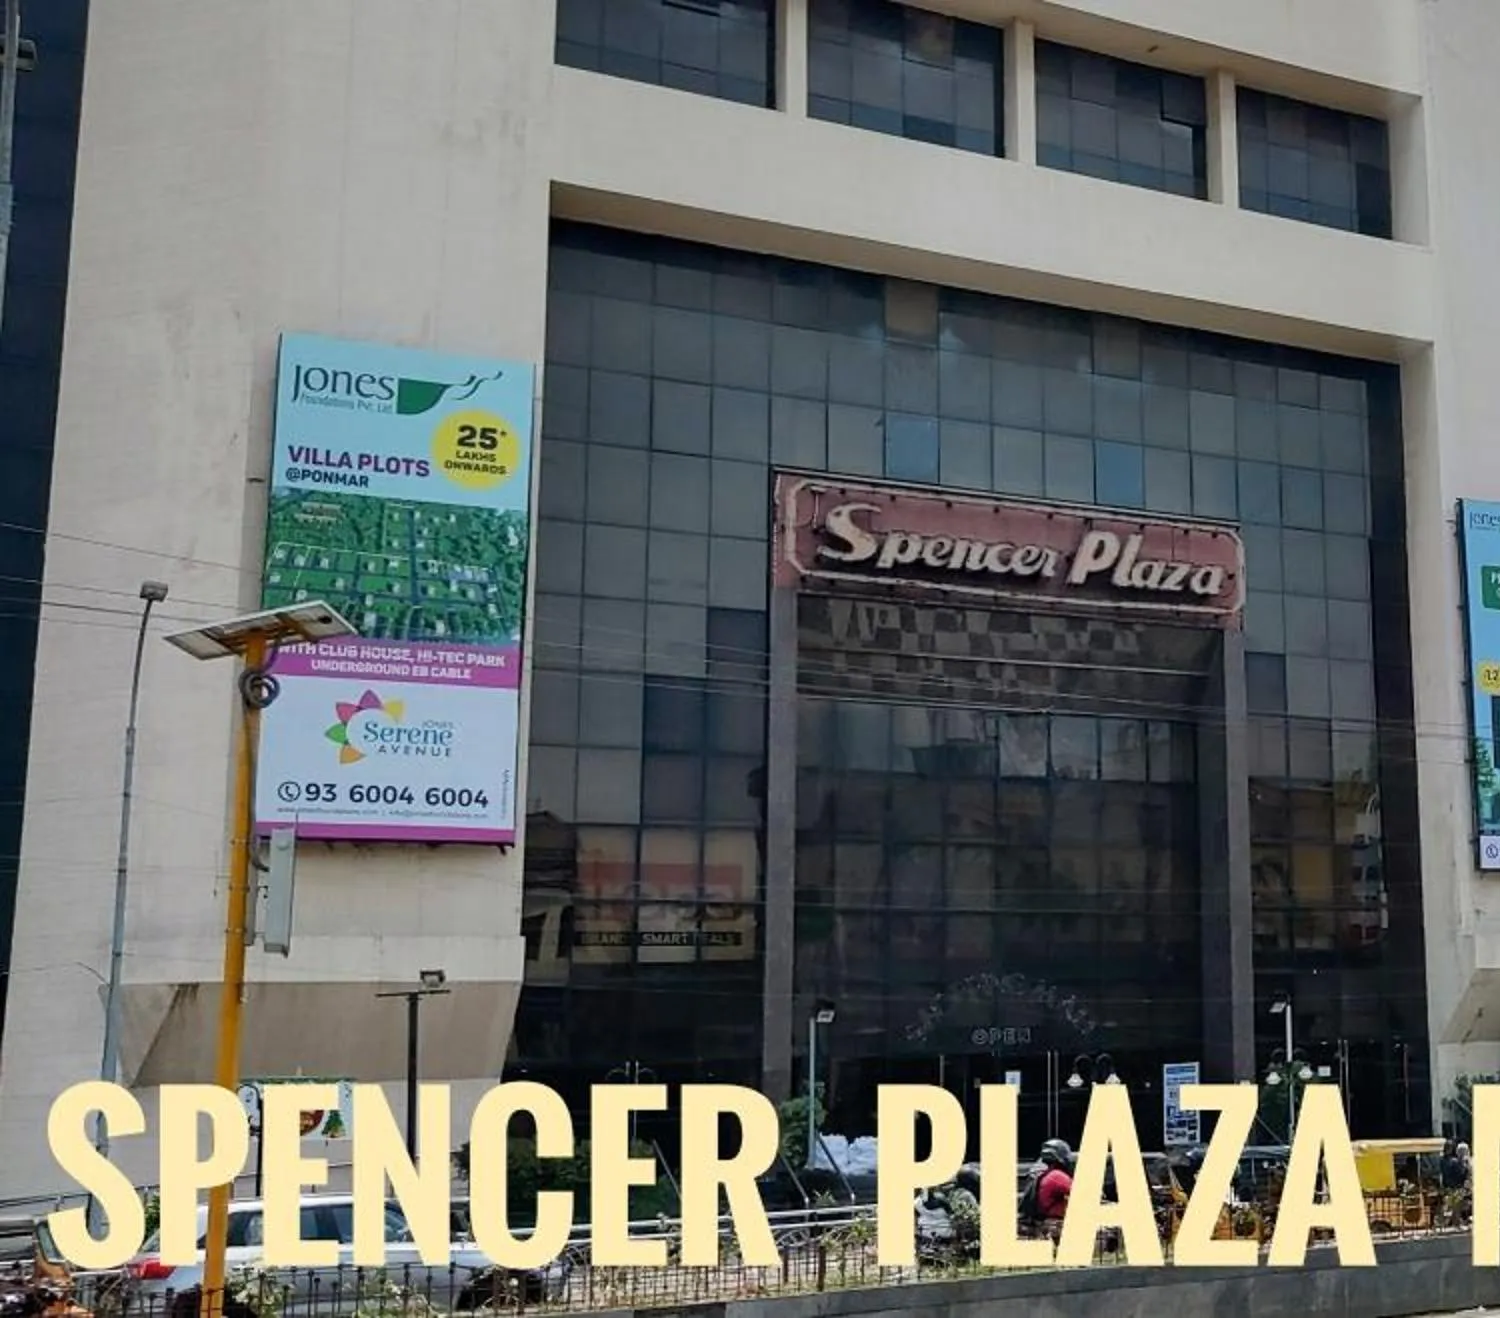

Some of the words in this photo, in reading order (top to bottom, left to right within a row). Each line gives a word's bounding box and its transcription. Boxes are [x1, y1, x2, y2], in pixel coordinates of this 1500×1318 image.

[288, 445, 353, 470] VILLA
[358, 453, 430, 477] PLOTS
[455, 450, 496, 463] LAKHS
[285, 467, 370, 488] @PONMAR
[444, 459, 507, 476] ONWARDS
[817, 502, 1057, 578] Spencer
[1067, 530, 1227, 596] Plaza
[318, 643, 359, 659] CLUB
[360, 647, 415, 663] HOUSE,
[417, 650, 465, 665] HI-TEC
[467, 652, 506, 667] PARK
[311, 660, 410, 677] UNDERGROUND
[431, 666, 472, 680] CABLE
[363, 720, 453, 746] Serene
[378, 744, 452, 757] AVENUE
[305, 783, 337, 802] 93
[350, 784, 414, 804] 6004
[425, 787, 489, 808] 6004
[642, 933, 688, 945] SMART
